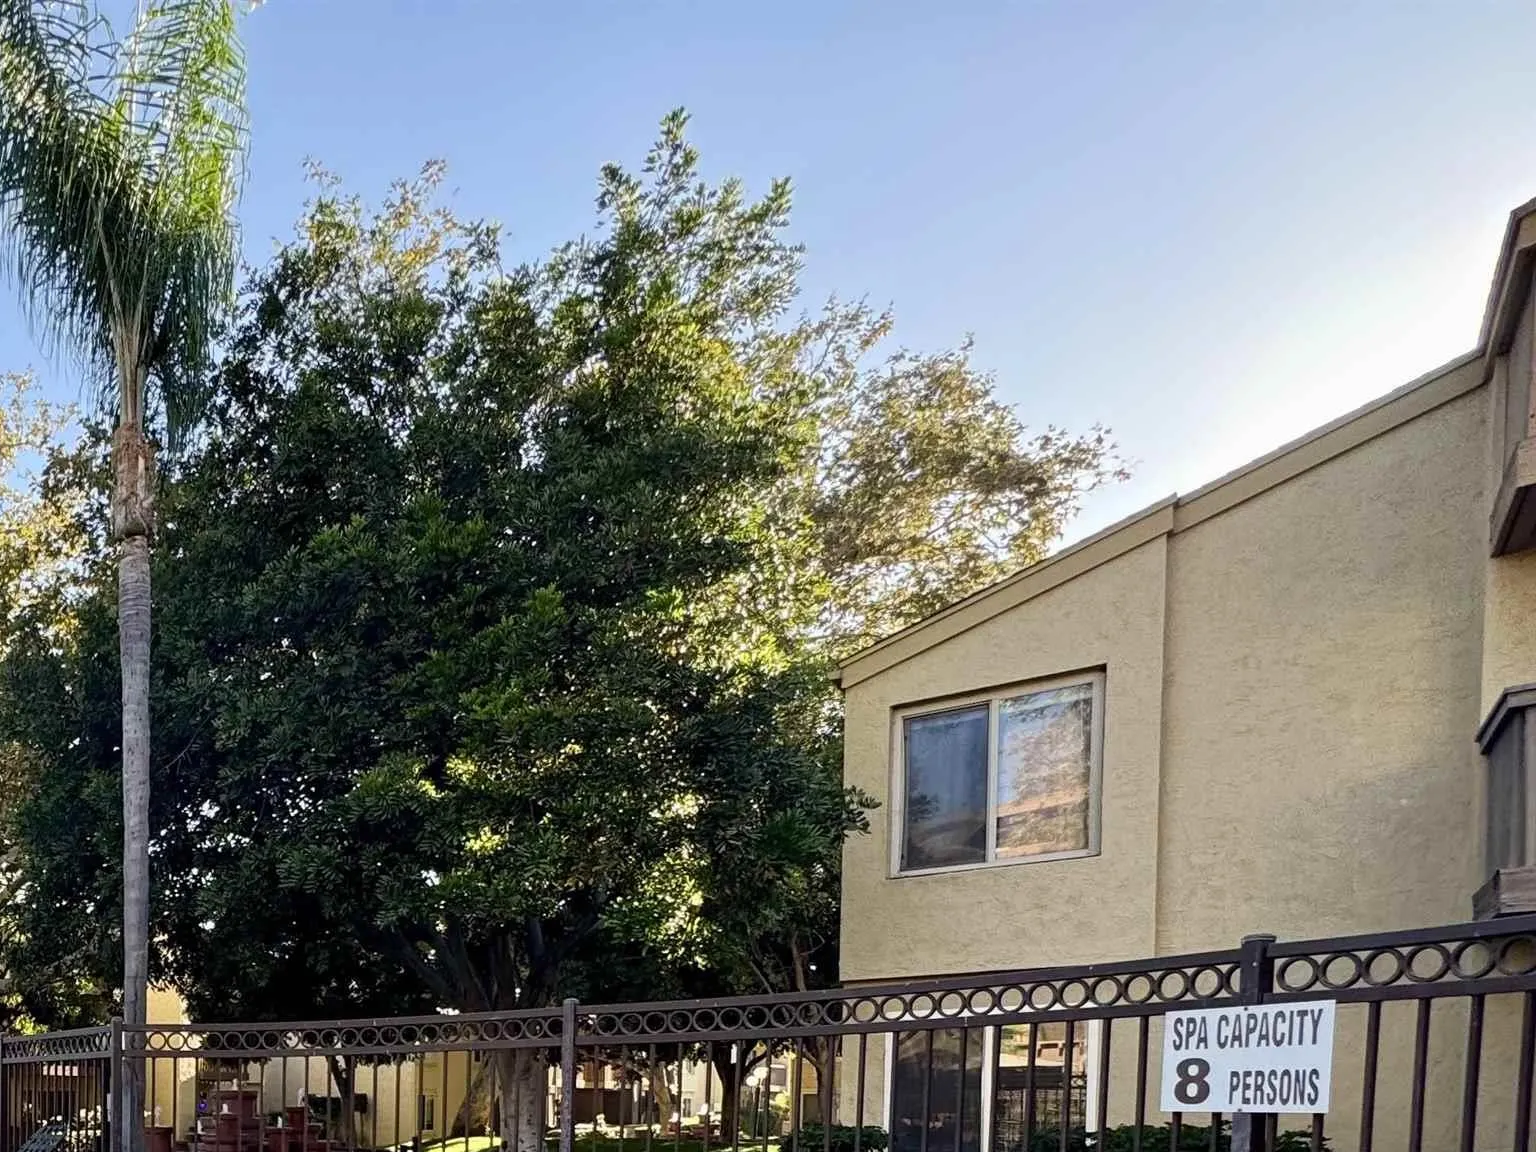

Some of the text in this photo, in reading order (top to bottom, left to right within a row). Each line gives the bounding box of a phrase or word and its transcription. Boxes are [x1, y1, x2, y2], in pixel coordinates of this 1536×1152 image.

[1172, 1008, 1324, 1051] SPA CAPACITY
[1174, 1057, 1320, 1106] 8 PERSONS
